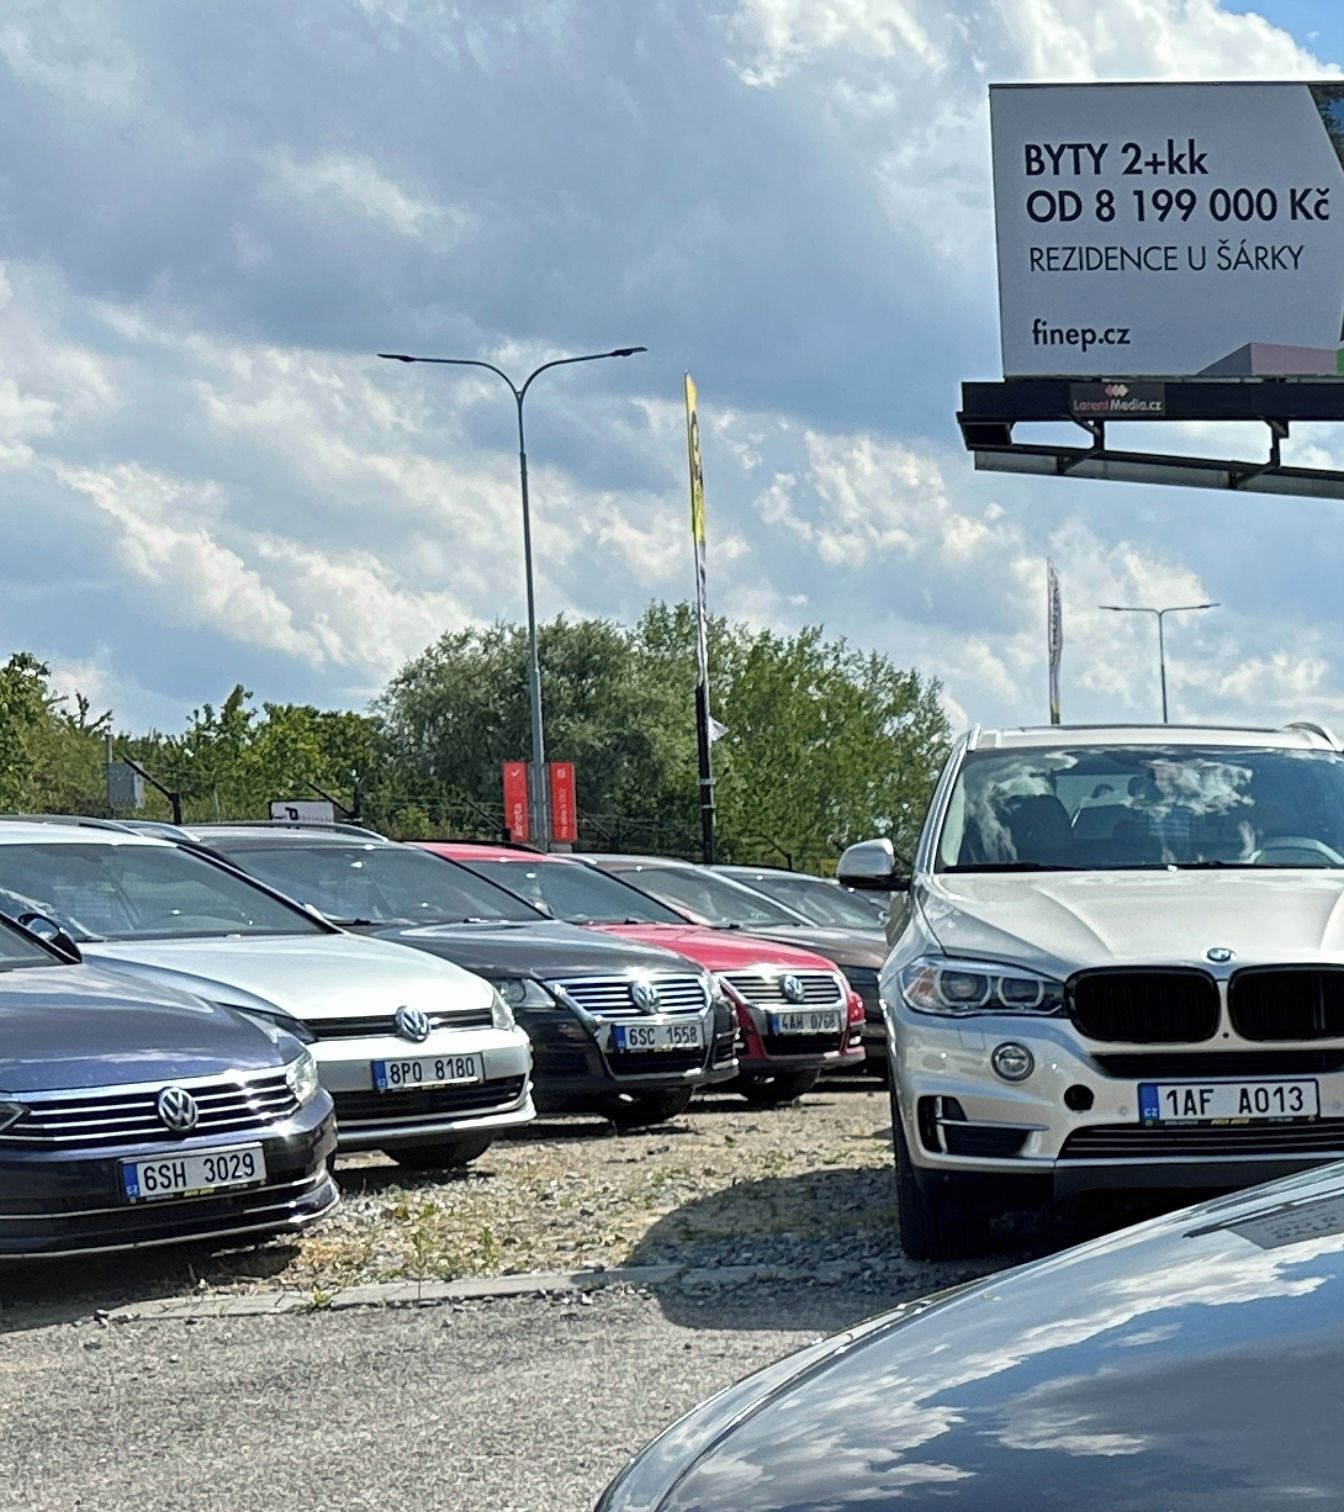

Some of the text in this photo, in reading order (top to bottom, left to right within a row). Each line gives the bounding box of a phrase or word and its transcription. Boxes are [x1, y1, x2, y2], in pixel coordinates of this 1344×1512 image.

[1024, 138, 1209, 176] BYTY 2+kk
[1026, 187, 1330, 223] OD 8 199 000 Kč
[1030, 238, 1305, 272] REZIDENCE U ŠÁRKY
[1032, 318, 1131, 351] finep.cz
[629, 1028, 655, 1046] 6SC
[435, 1057, 475, 1080] 8180
[1144, 1108, 1158, 1117] CZ
[1166, 1086, 1304, 1116] 1AF A013
[143, 1152, 255, 1191] 6SH 3029
